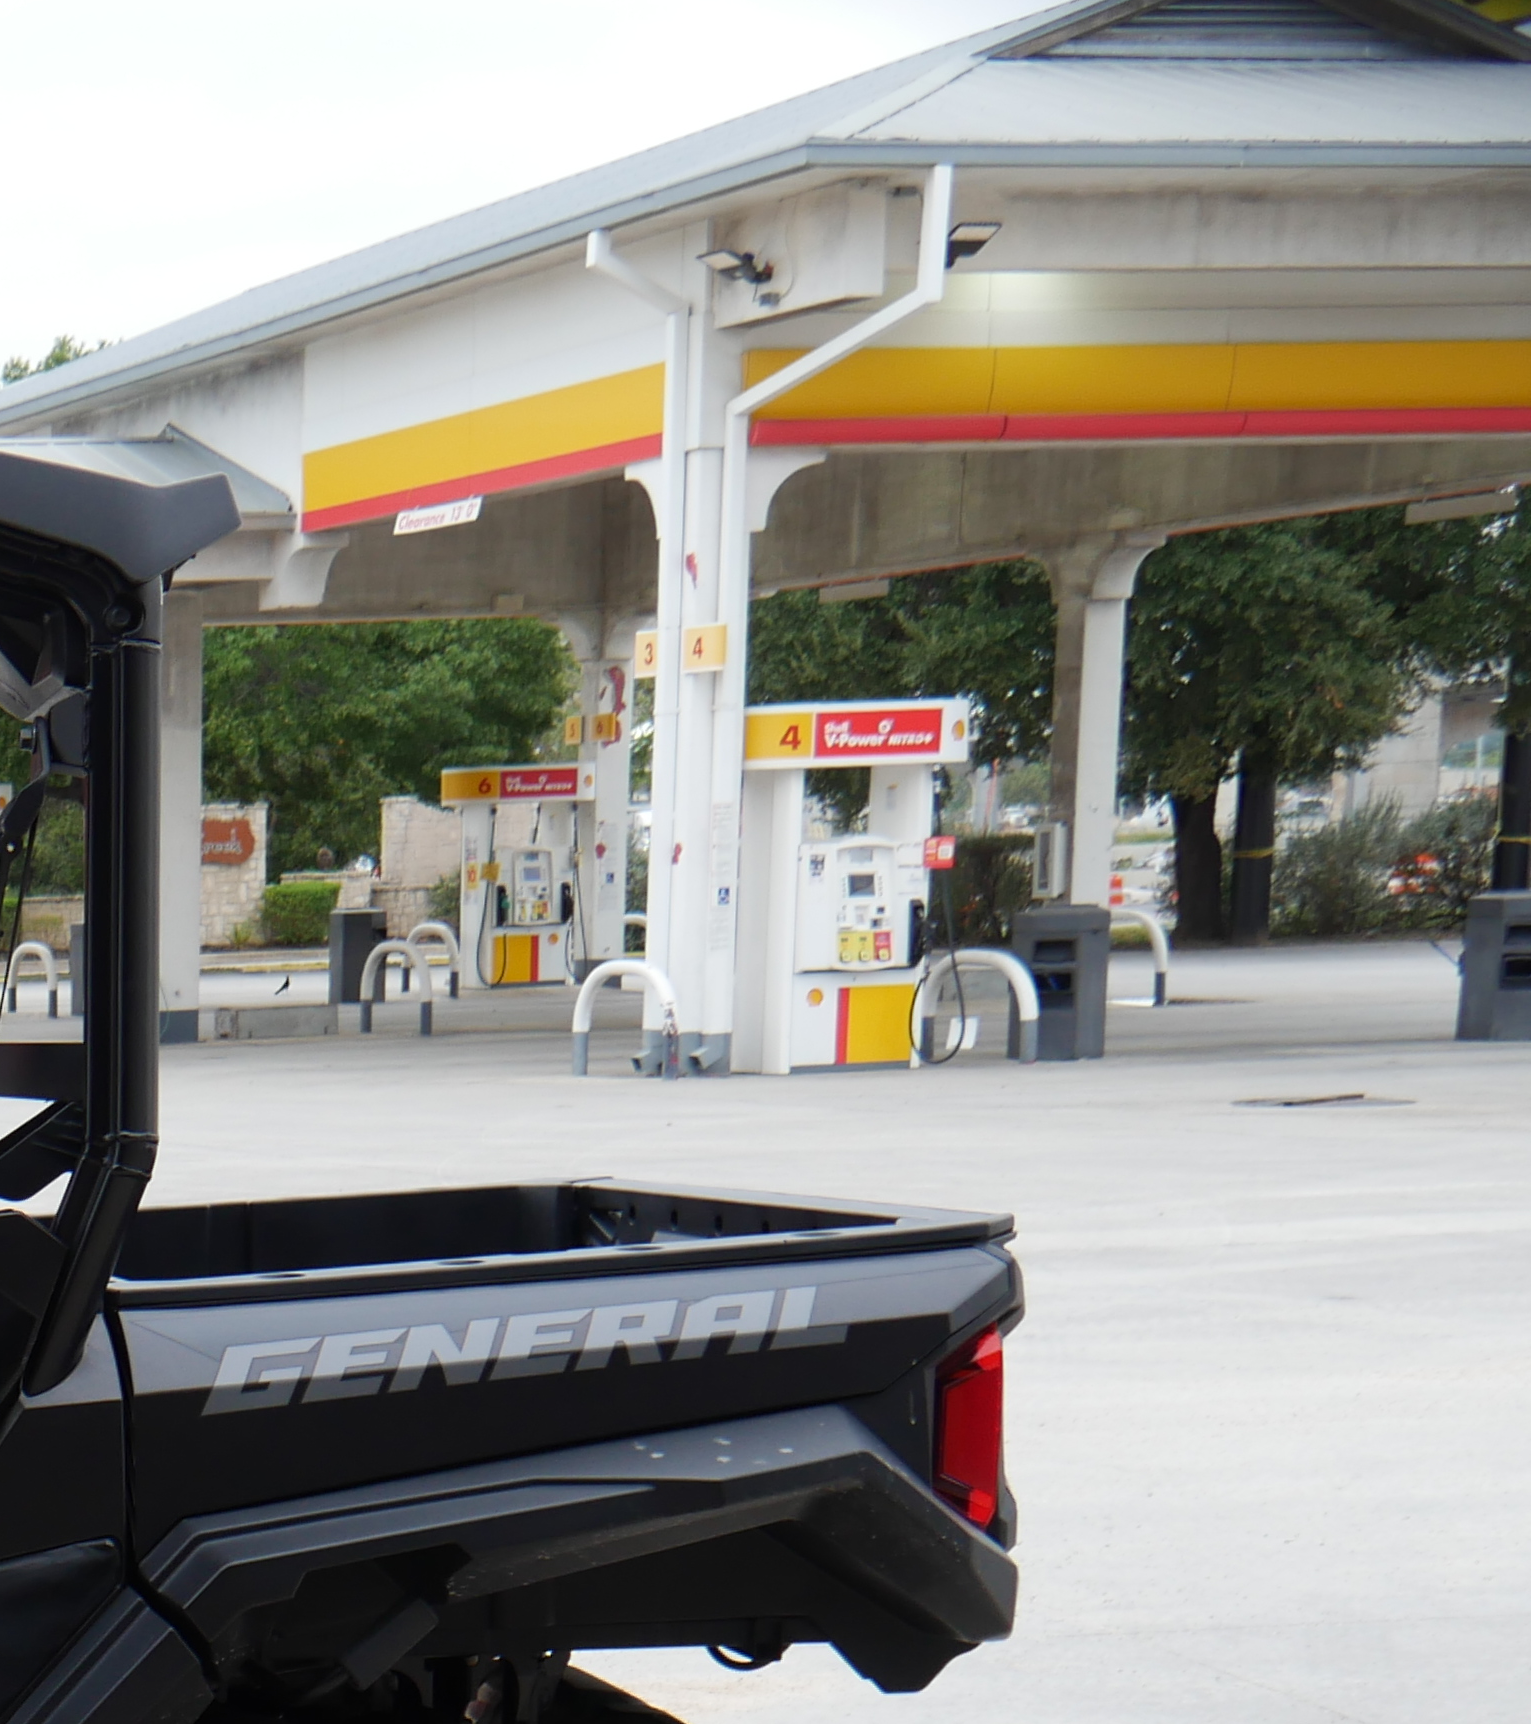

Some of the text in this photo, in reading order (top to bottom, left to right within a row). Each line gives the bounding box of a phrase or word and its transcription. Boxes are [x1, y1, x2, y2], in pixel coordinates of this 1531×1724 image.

[643, 642, 654, 666] 3
[692, 636, 704, 660] 4
[596, 720, 604, 734] 6
[779, 724, 802, 751] 4
[824, 732, 888, 749] V-Power
[478, 777, 492, 794] 6
[200, 1285, 849, 1417] GENERAL
